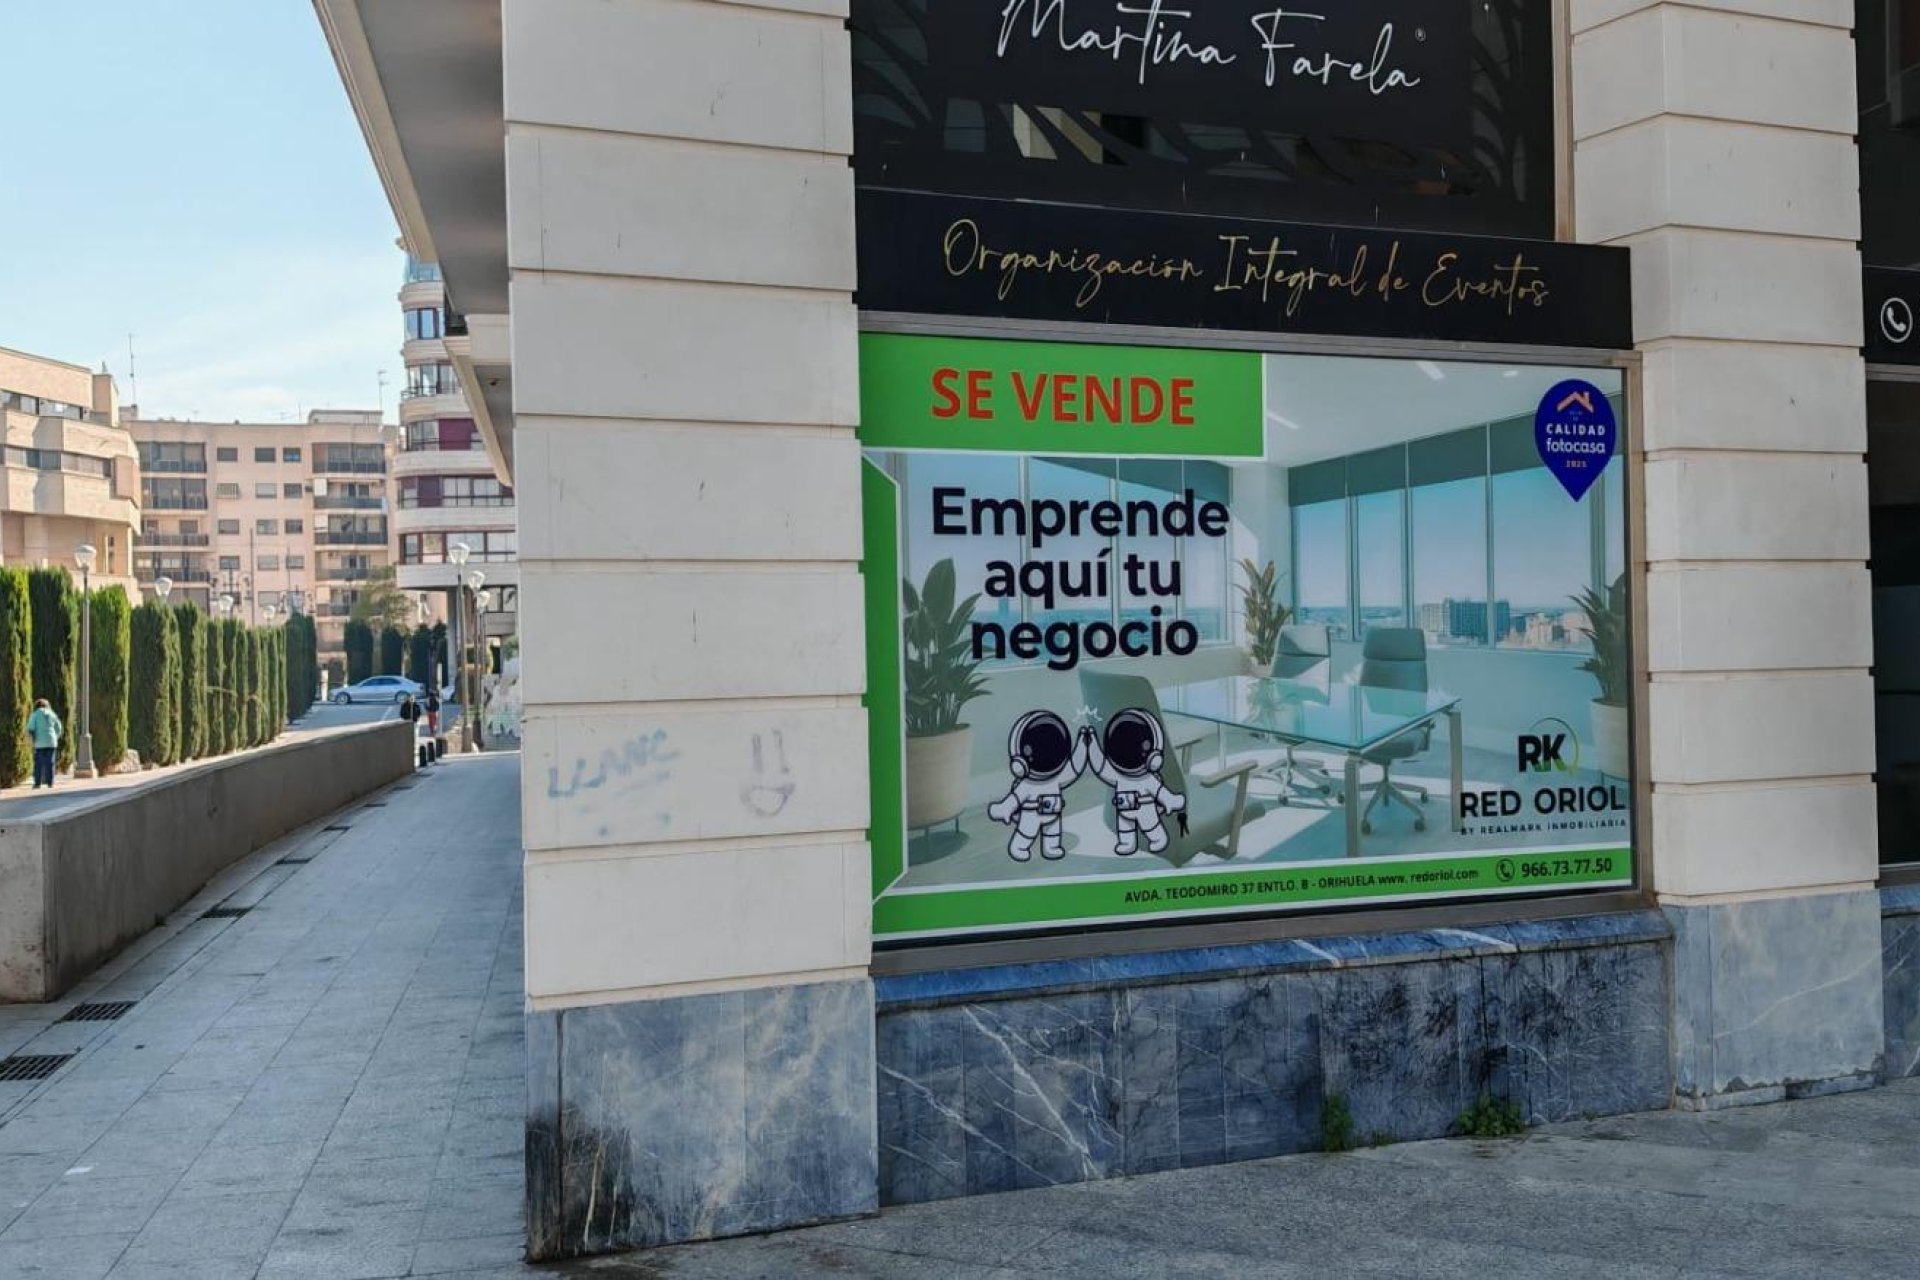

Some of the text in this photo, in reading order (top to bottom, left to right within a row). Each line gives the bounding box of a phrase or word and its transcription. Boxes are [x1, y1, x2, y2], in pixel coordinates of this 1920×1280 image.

[997, 0, 1421, 95] Martina Farela
[944, 218, 1550, 317] Organización Integral de Eventos
[931, 368, 1195, 426] SE VENDE
[1546, 422, 1606, 436] CALIDAD
[1546, 437, 1606, 455] fotocasa
[932, 486, 1230, 548] Emprende
[984, 548, 1182, 610] aquí tu
[970, 604, 1199, 672] negocio
[1517, 733, 1567, 773] RK
[1460, 785, 1627, 819] RED ORIOL
[1480, 822, 1543, 835] REALMARK
[1125, 888, 1161, 903] AVDA.
[1166, 883, 1239, 900] TEODOMIRO
[1241, 883, 1254, 894] 37
[1318, 874, 1375, 889] ORIHUELA
[1410, 868, 1479, 884] redoriol.com
[1521, 857, 1613, 878] 966.73.77.50
